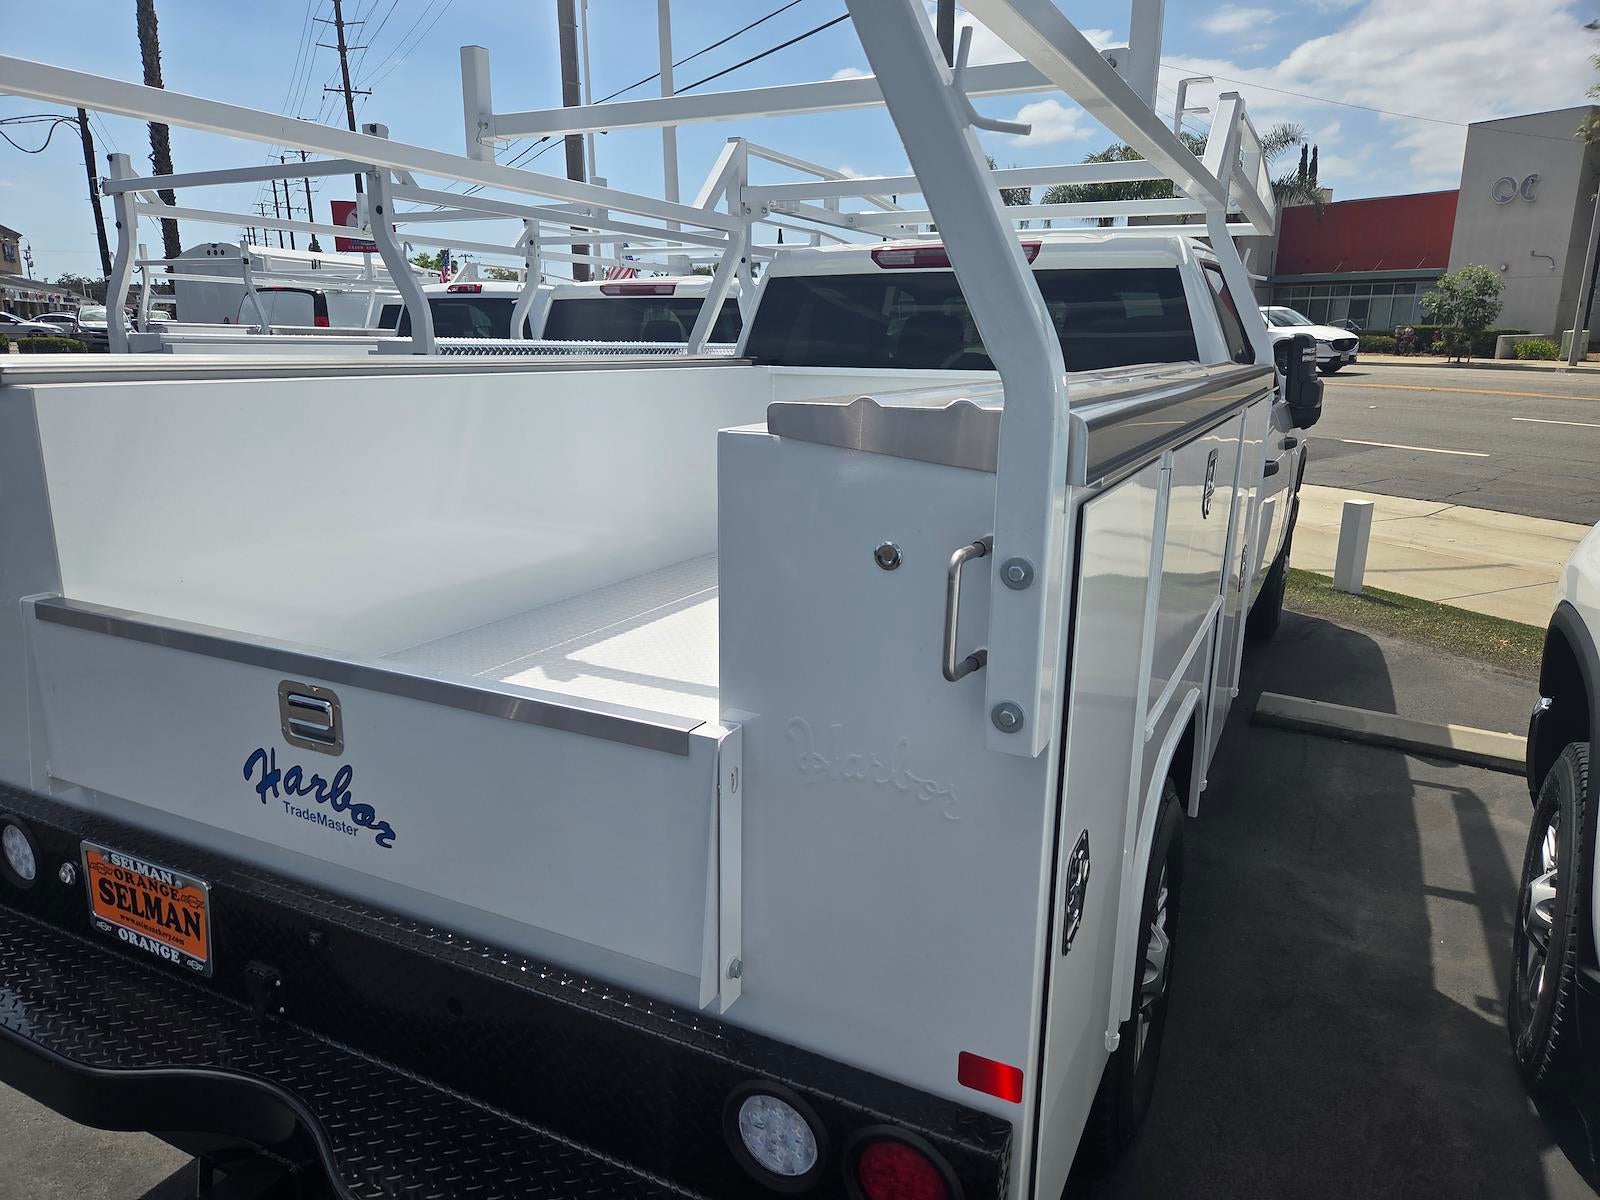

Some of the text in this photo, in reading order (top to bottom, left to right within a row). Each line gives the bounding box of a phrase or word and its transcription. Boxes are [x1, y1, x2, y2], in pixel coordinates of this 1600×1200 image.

[243, 747, 396, 849] Harbor
[282, 800, 359, 837] TradeMaster
[110, 853, 176, 887] SELMAN
[113, 868, 180, 902] ORANGE
[98, 877, 201, 942] SELMAN
[117, 927, 181, 965] ORANGE
